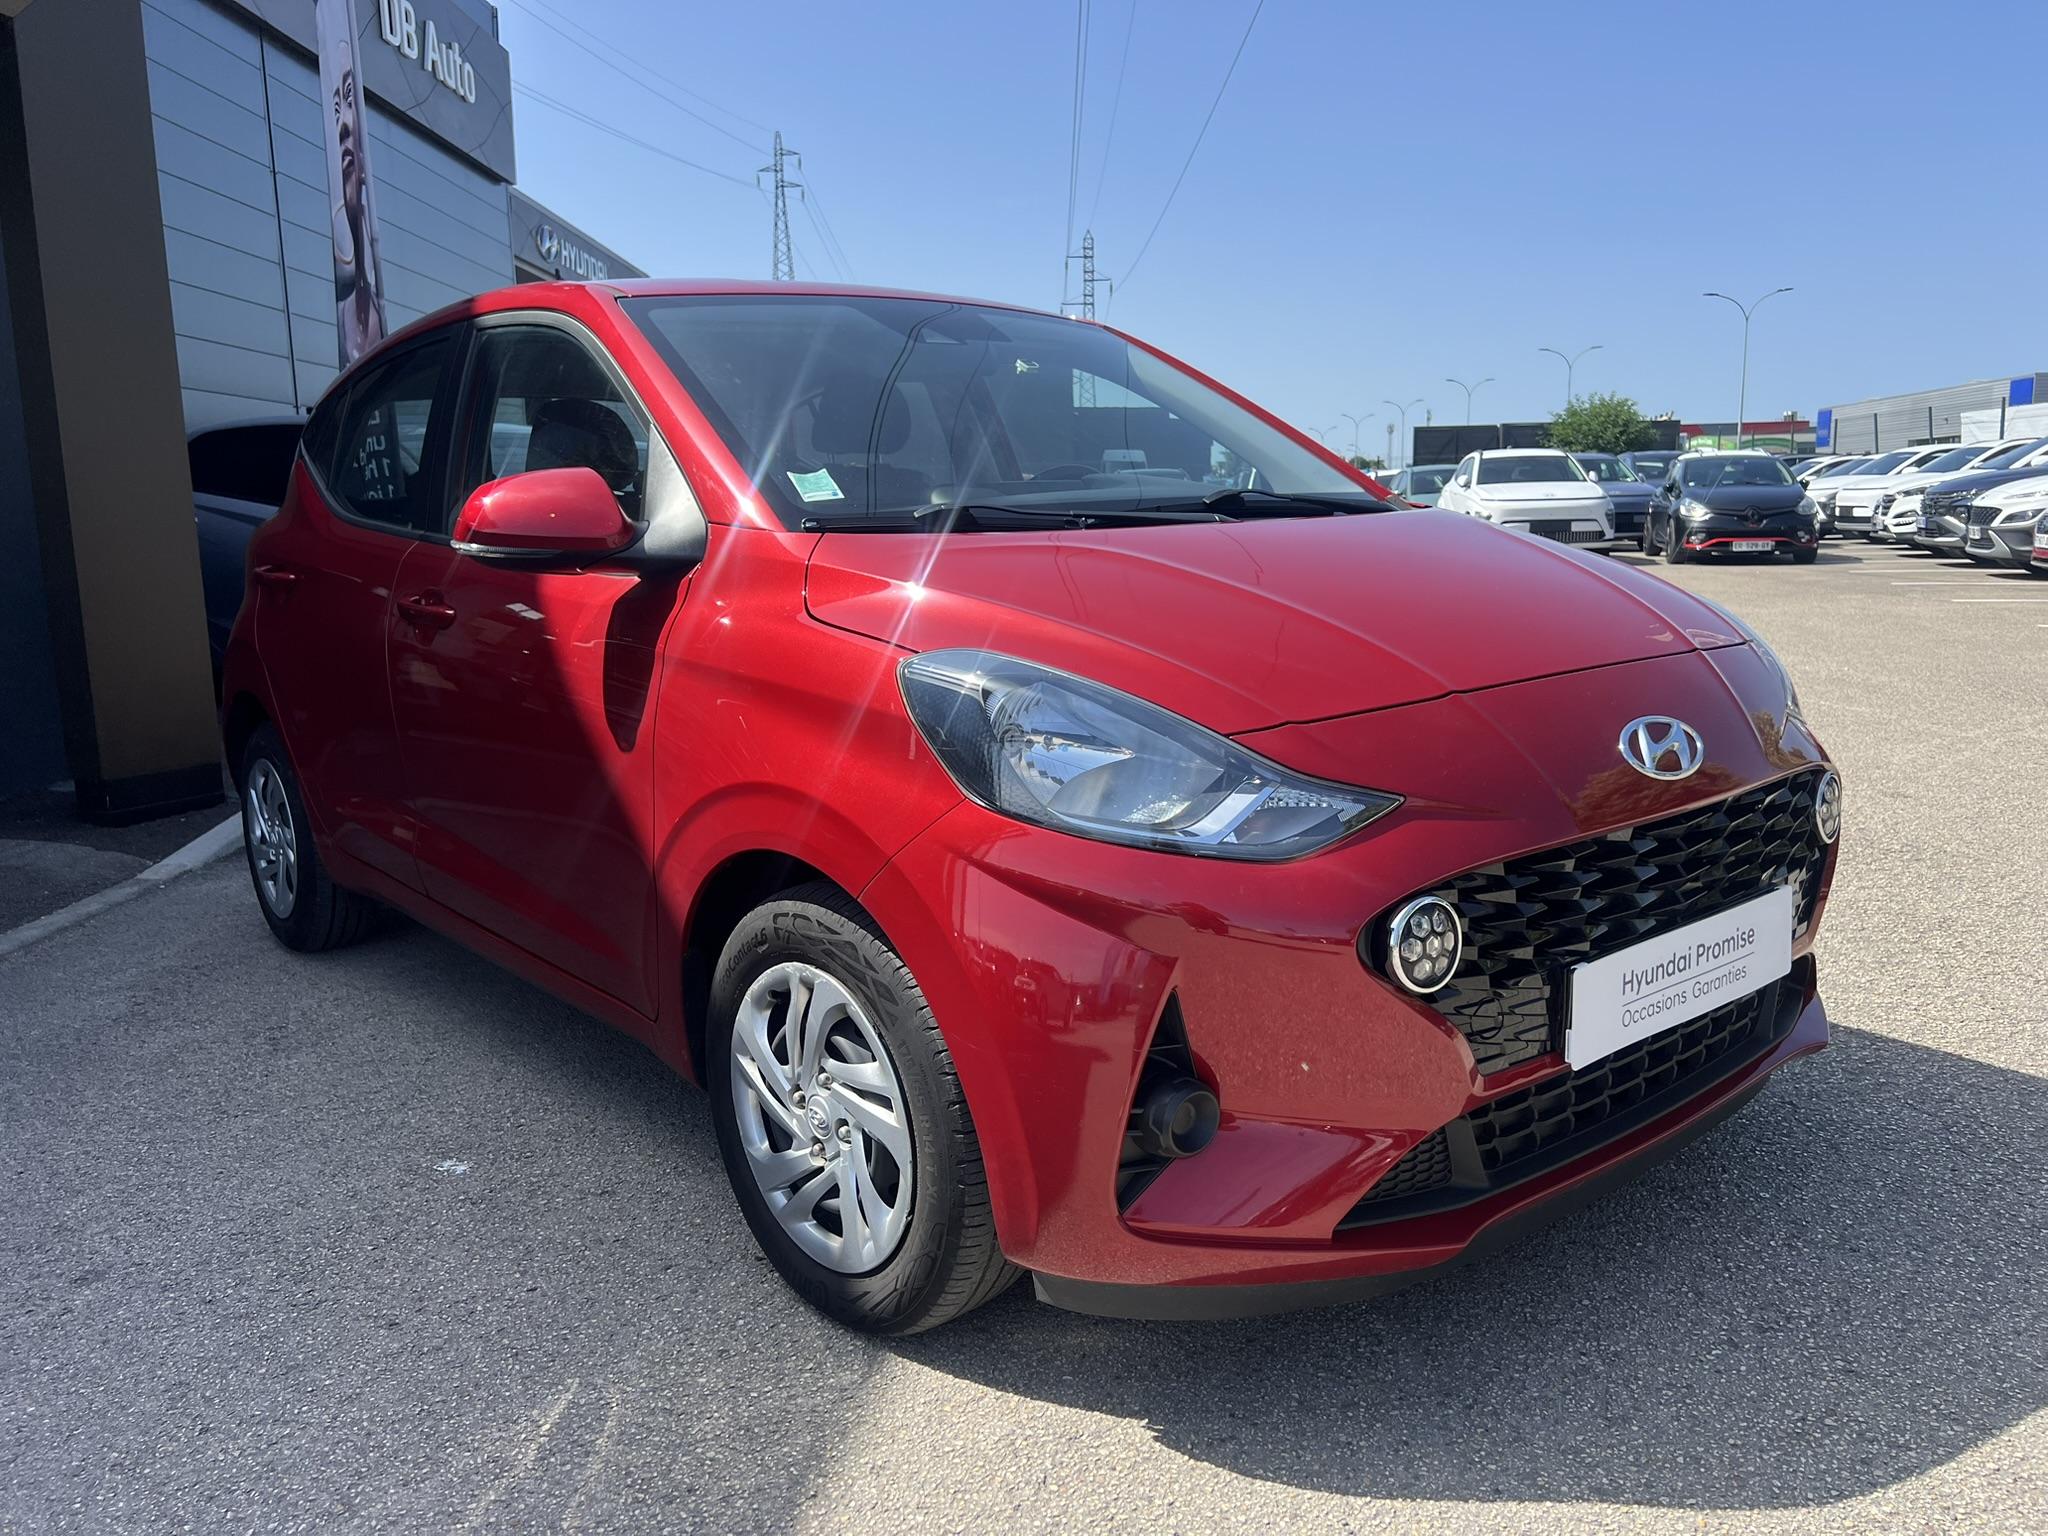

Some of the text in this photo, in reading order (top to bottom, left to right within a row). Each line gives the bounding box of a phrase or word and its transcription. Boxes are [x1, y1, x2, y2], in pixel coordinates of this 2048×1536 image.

[379, 0, 476, 104] DB Auto
[1622, 926, 1755, 996] Hyundai Promise
[1621, 965, 1748, 1028] Occasions Garanties
